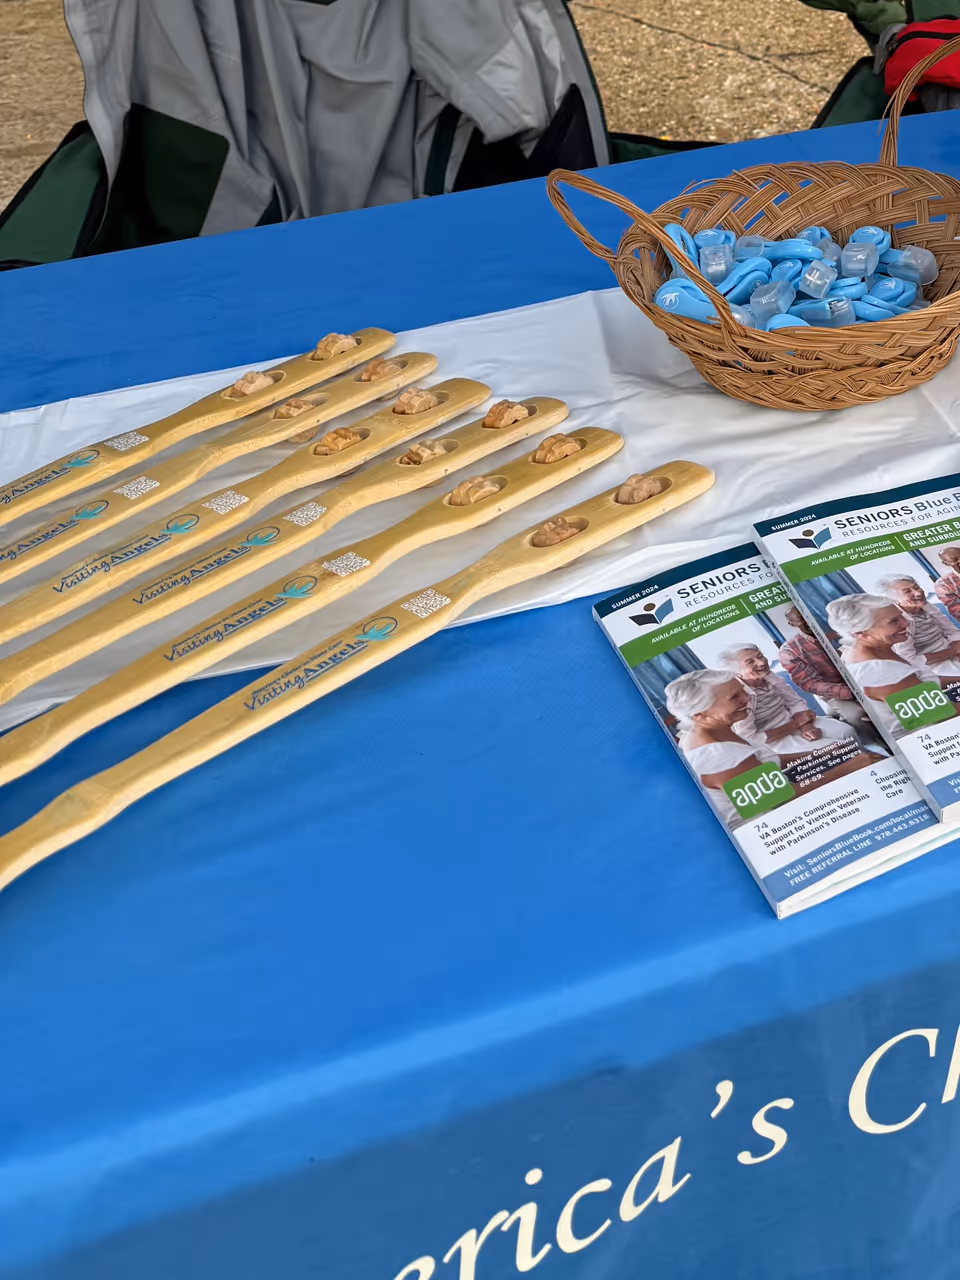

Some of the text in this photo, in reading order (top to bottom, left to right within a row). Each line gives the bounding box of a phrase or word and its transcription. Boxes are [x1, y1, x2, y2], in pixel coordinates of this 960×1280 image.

[771, 514, 816, 531] SUMMER 2024
[834, 497, 952, 529] SENIORS Blue
[842, 519, 908, 538] RESOURCES
[911, 513, 932, 522] FOR
[903, 524, 952, 541] GREATER
[909, 539, 926, 547] AND
[811, 540, 891, 566] AVAILABLE HUNDREDS
[860, 545, 895, 557] LOCATIONS
[677, 563, 761, 599] SENIORS
[685, 578, 755, 608] RESOURCES
[749, 585, 786, 603] GREAT
[612, 585, 659, 609] SUMMER 2024
[755, 599, 773, 610] AND
[651, 604, 736, 644] AVAILABLE HUNDREDS
[692, 610, 740, 633] OF LOCATIONS
[786, 736, 855, 769] Making Connections
[795, 748, 862, 782] Services. pages
[797, 741, 859, 771] Parkinson Support
[754, 822, 768, 833] 74
[759, 788, 859, 840] VA Boston's Comprehensive
[765, 792, 870, 848] Support for Vietnam Veterans
[769, 807, 860, 856] with Parkinson's Disease
[789, 814, 929, 886] FREE REFERRAL LINE 978.443.8318
